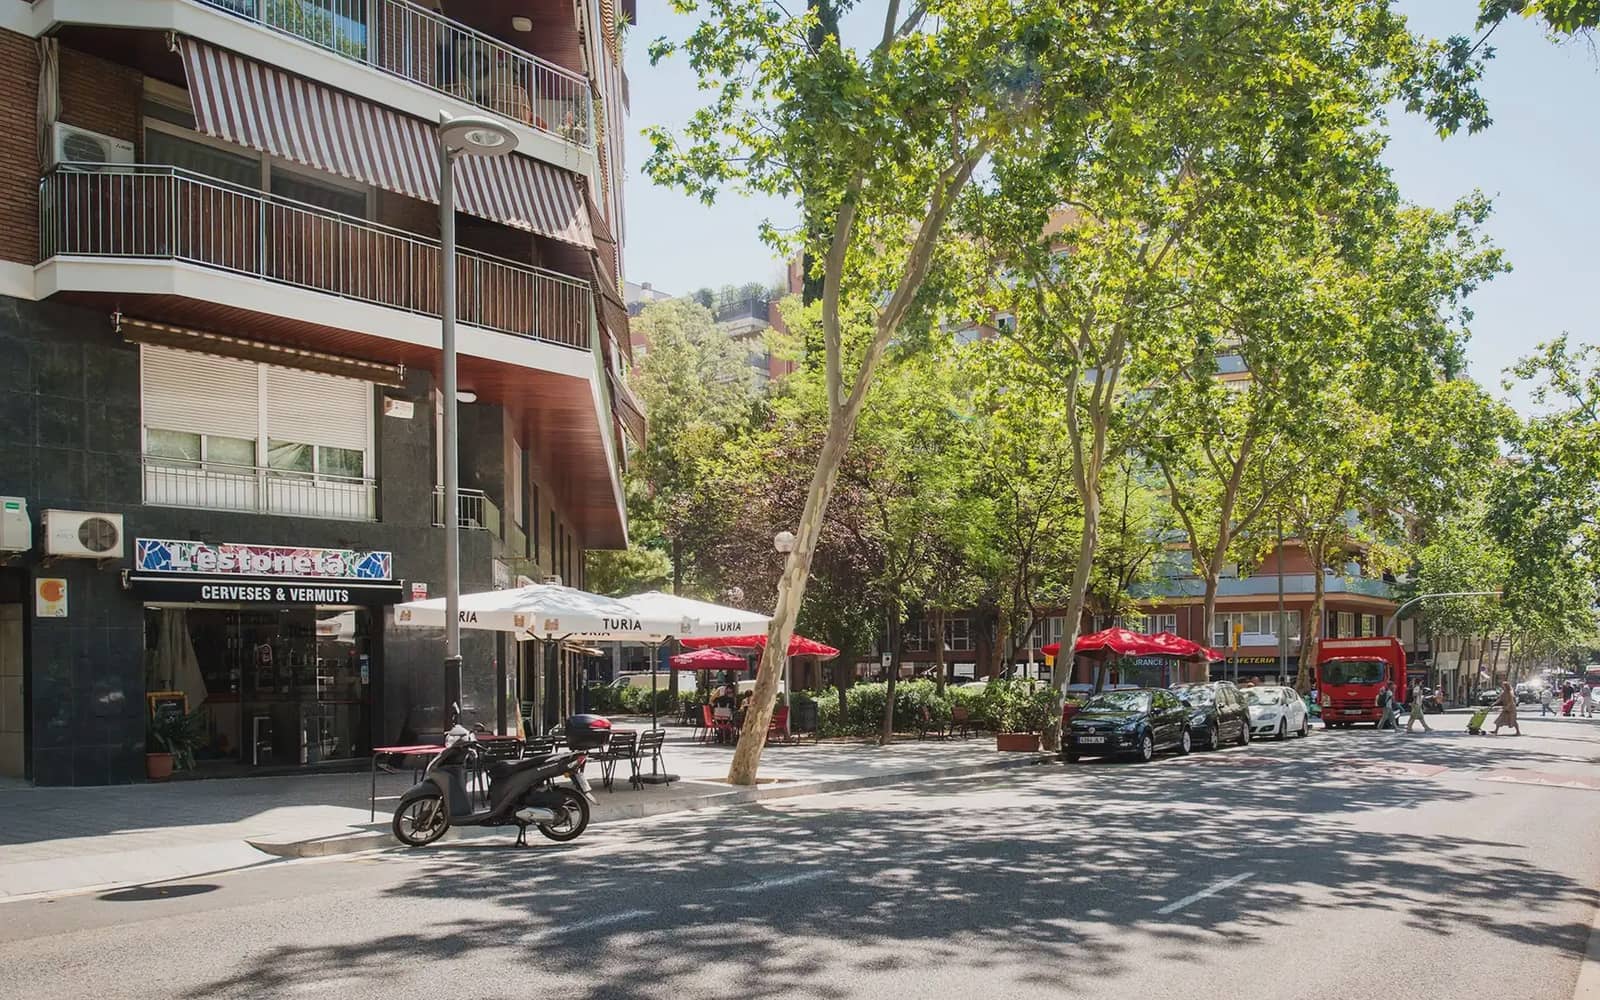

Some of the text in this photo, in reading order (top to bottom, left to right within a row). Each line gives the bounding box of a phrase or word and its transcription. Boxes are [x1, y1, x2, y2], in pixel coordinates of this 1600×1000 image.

[202, 586, 349, 602] CERVESES & VERMUTS
[457, 611, 478, 623] RIA
[602, 618, 642, 631] TURIA
[714, 621, 742, 632] TURIA
